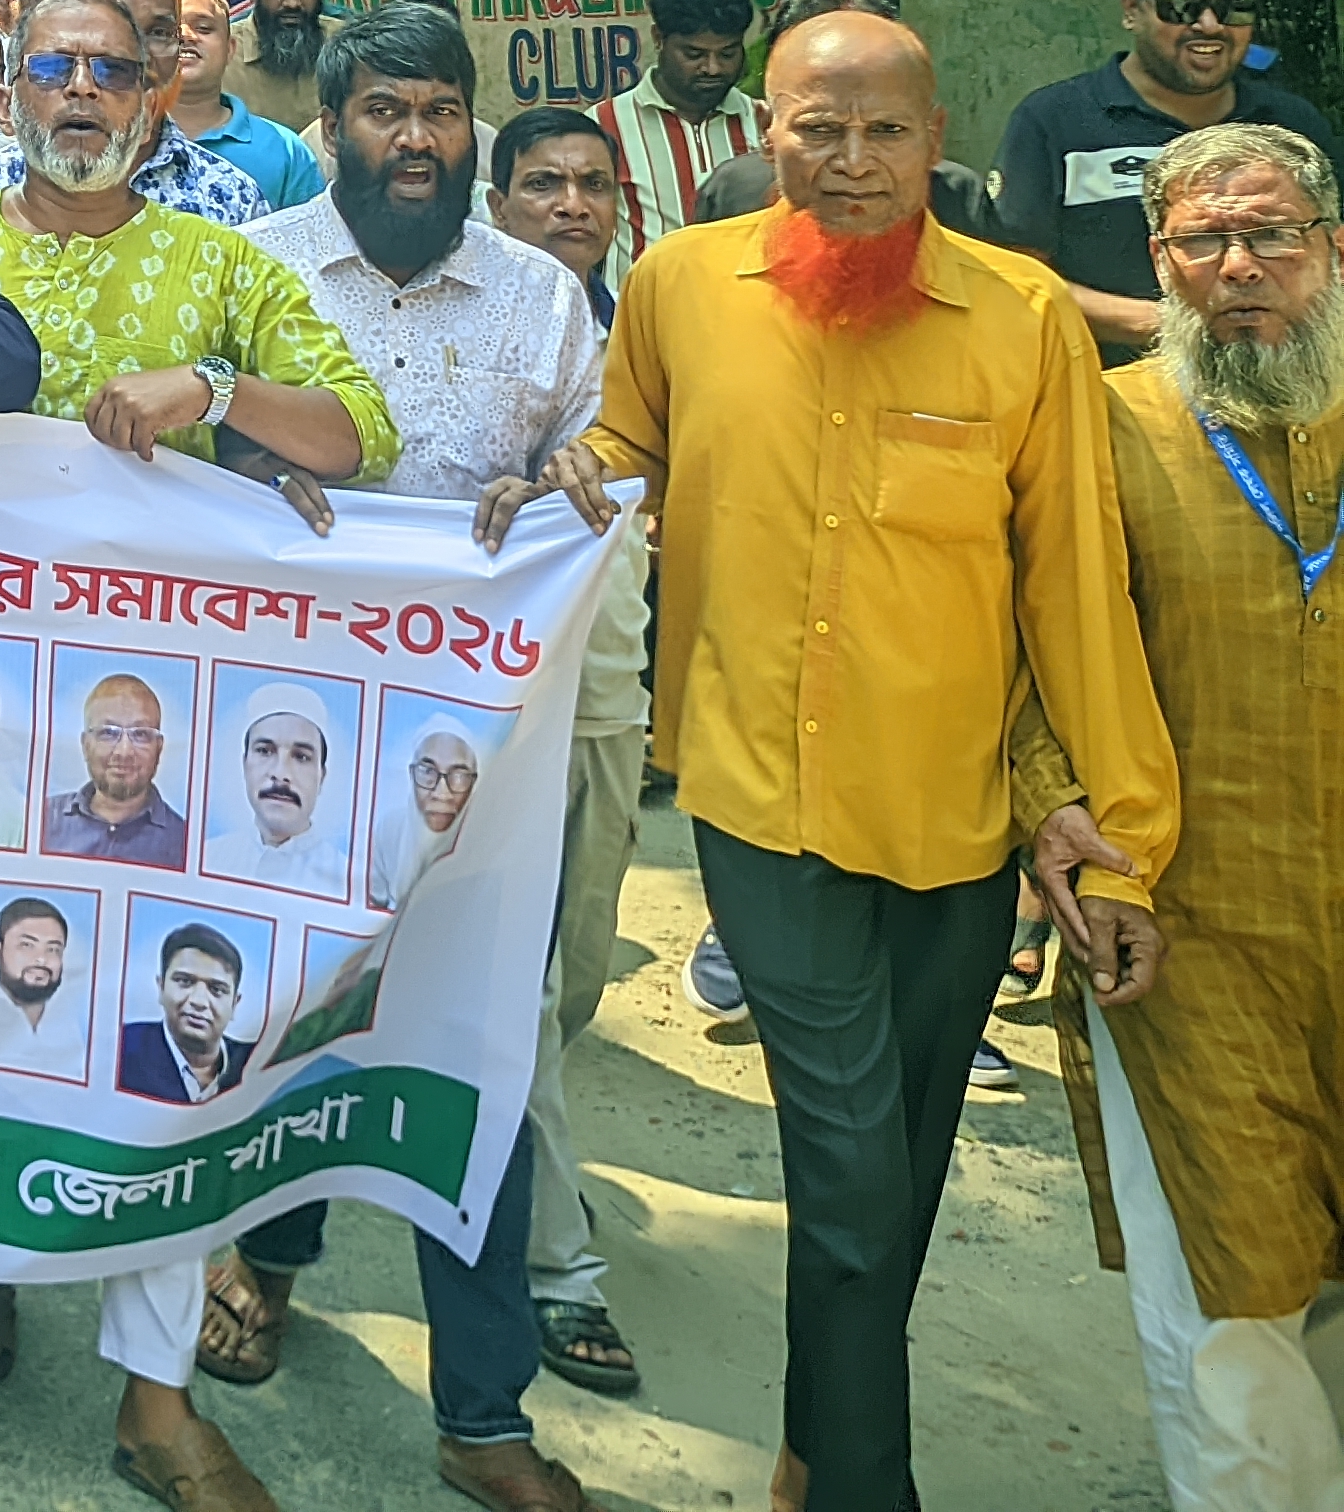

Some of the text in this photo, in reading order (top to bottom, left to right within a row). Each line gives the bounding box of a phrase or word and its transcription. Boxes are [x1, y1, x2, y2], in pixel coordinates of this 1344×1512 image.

[508, 24, 642, 106] CLUB
[53, 562, 542, 678] সমাবেশ-২০২৬
[19, 1157, 206, 1220] জেলা
[225, 1092, 363, 1174] শাখা
